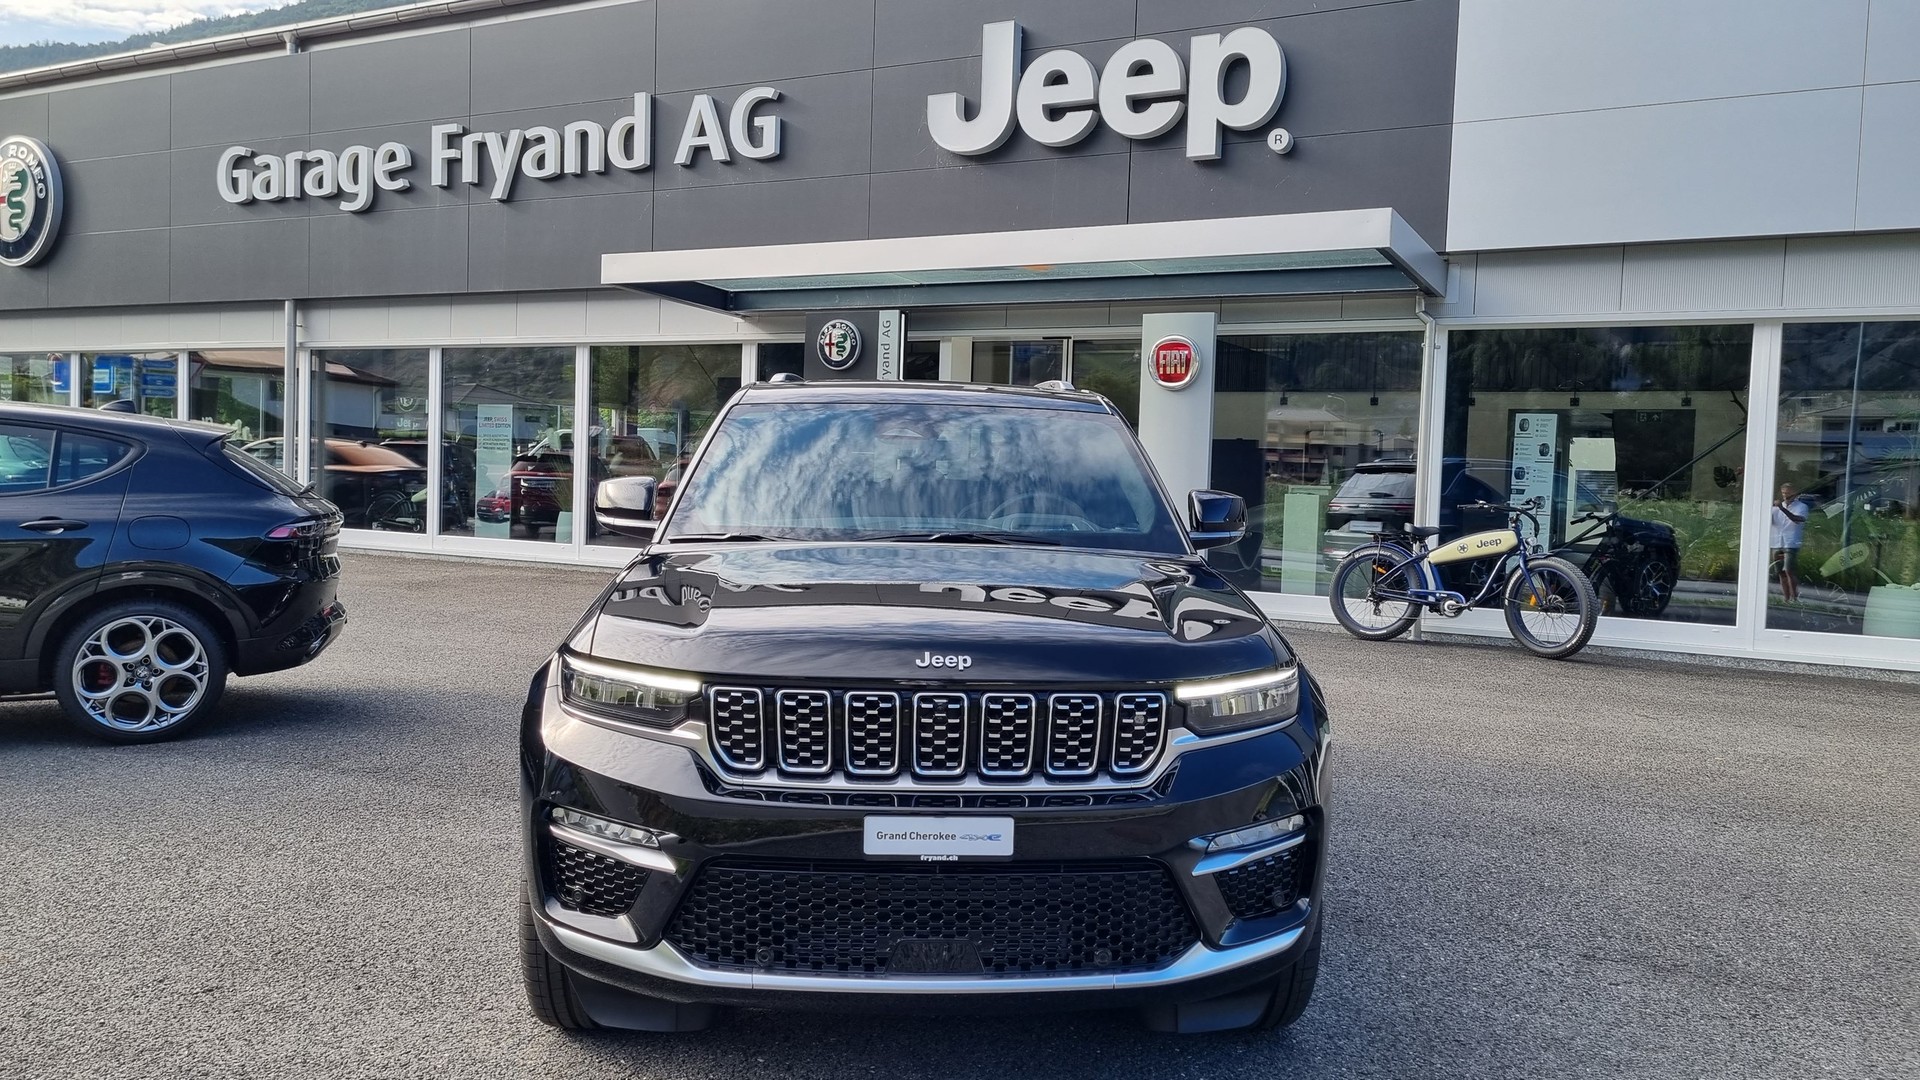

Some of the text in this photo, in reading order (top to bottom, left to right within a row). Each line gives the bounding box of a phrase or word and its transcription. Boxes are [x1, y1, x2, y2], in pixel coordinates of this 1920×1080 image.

[927, 20, 1288, 161] Jeep
[217, 87, 781, 213] Garage Fryand AG
[7, 144, 46, 200] ROMEO
[882, 319, 892, 338] AG
[1159, 350, 1189, 374] FIAT
[1476, 538, 1502, 549] Jeep
[915, 651, 973, 670] Jeep
[876, 831, 907, 841] Grand
[909, 831, 957, 841] Cherokee
[920, 854, 959, 862] fryand.ch
